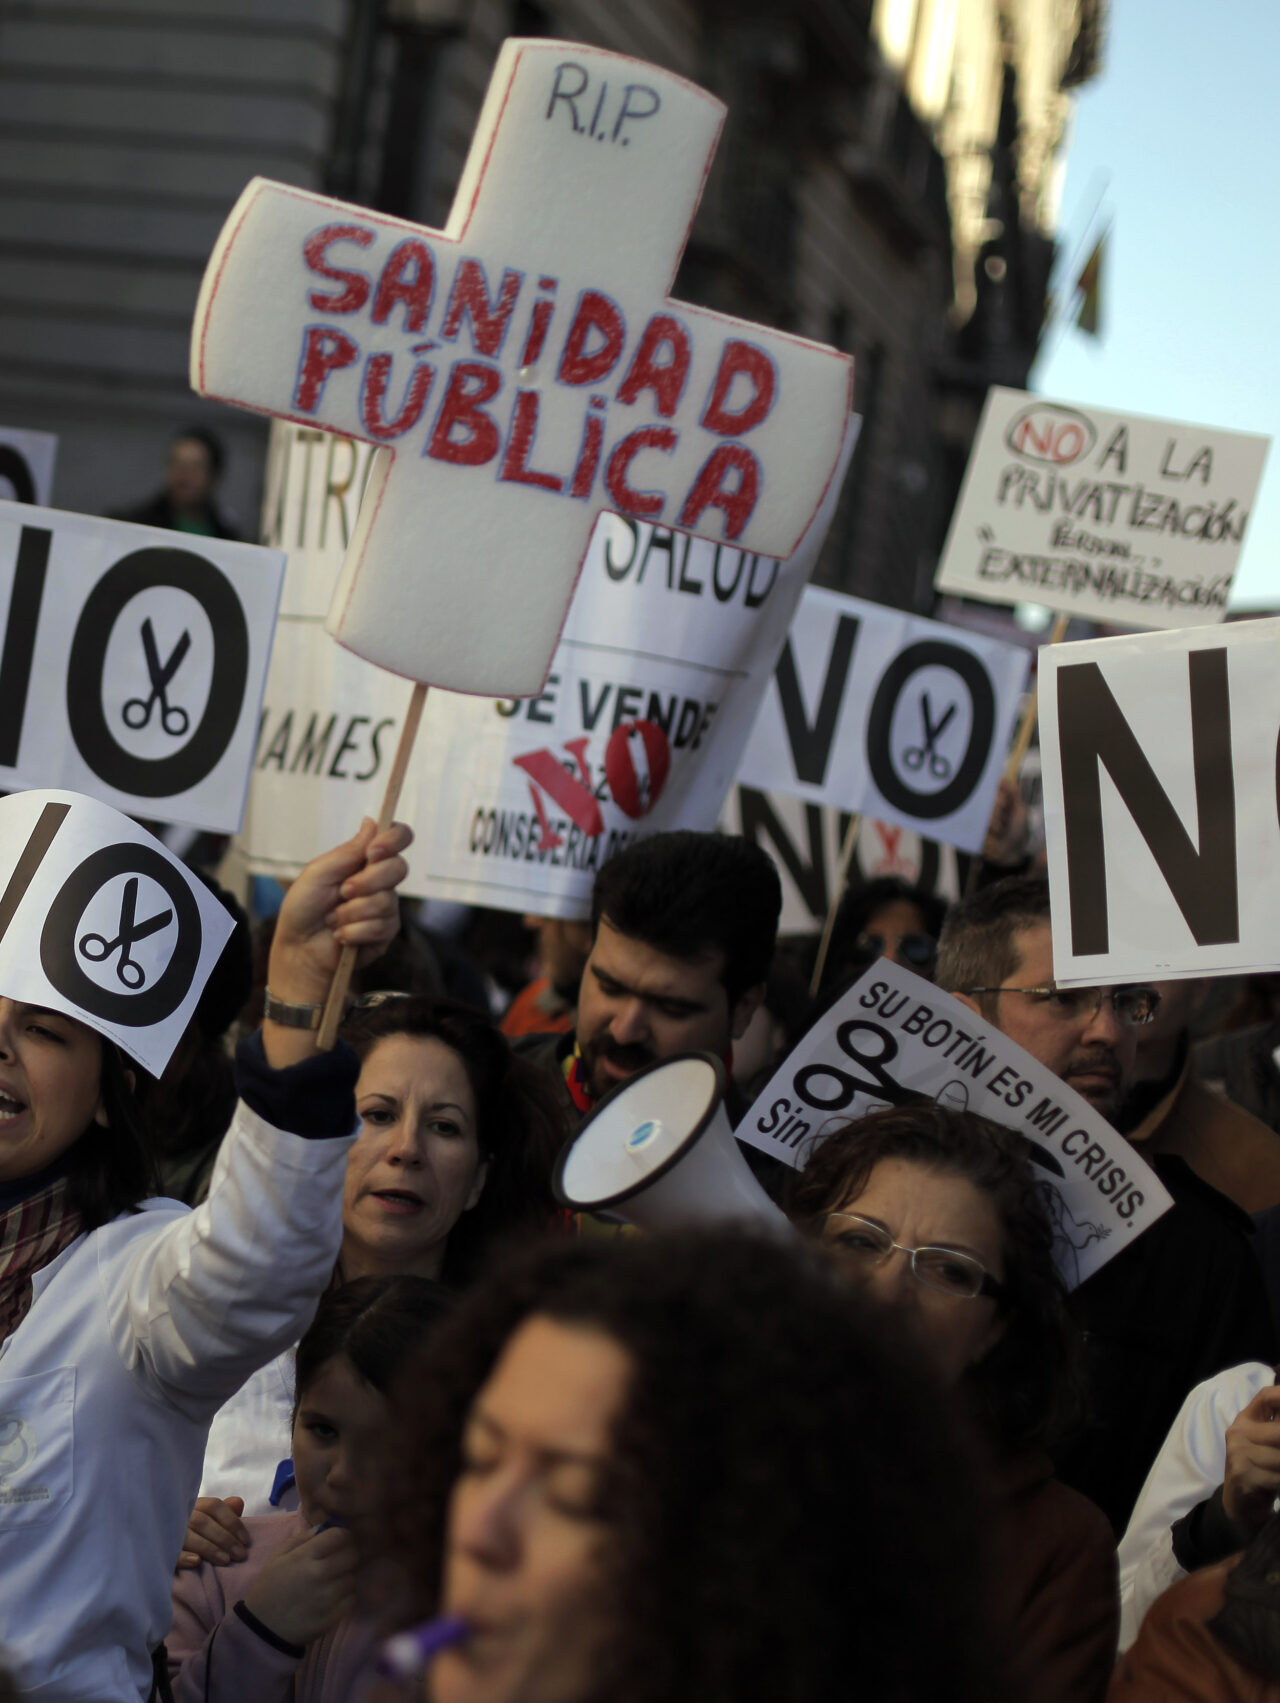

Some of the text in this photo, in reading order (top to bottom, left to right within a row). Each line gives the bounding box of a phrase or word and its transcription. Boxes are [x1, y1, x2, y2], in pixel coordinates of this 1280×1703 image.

[1013, 418, 1214, 486] NO A LA
[255, 706, 396, 781] AMES
[513, 718, 671, 821] NO
[1057, 647, 1280, 957] N
[757, 1097, 812, 1149] Sin
[859, 981, 1147, 1228] SU BOTÍN ES MI CRISIS.
